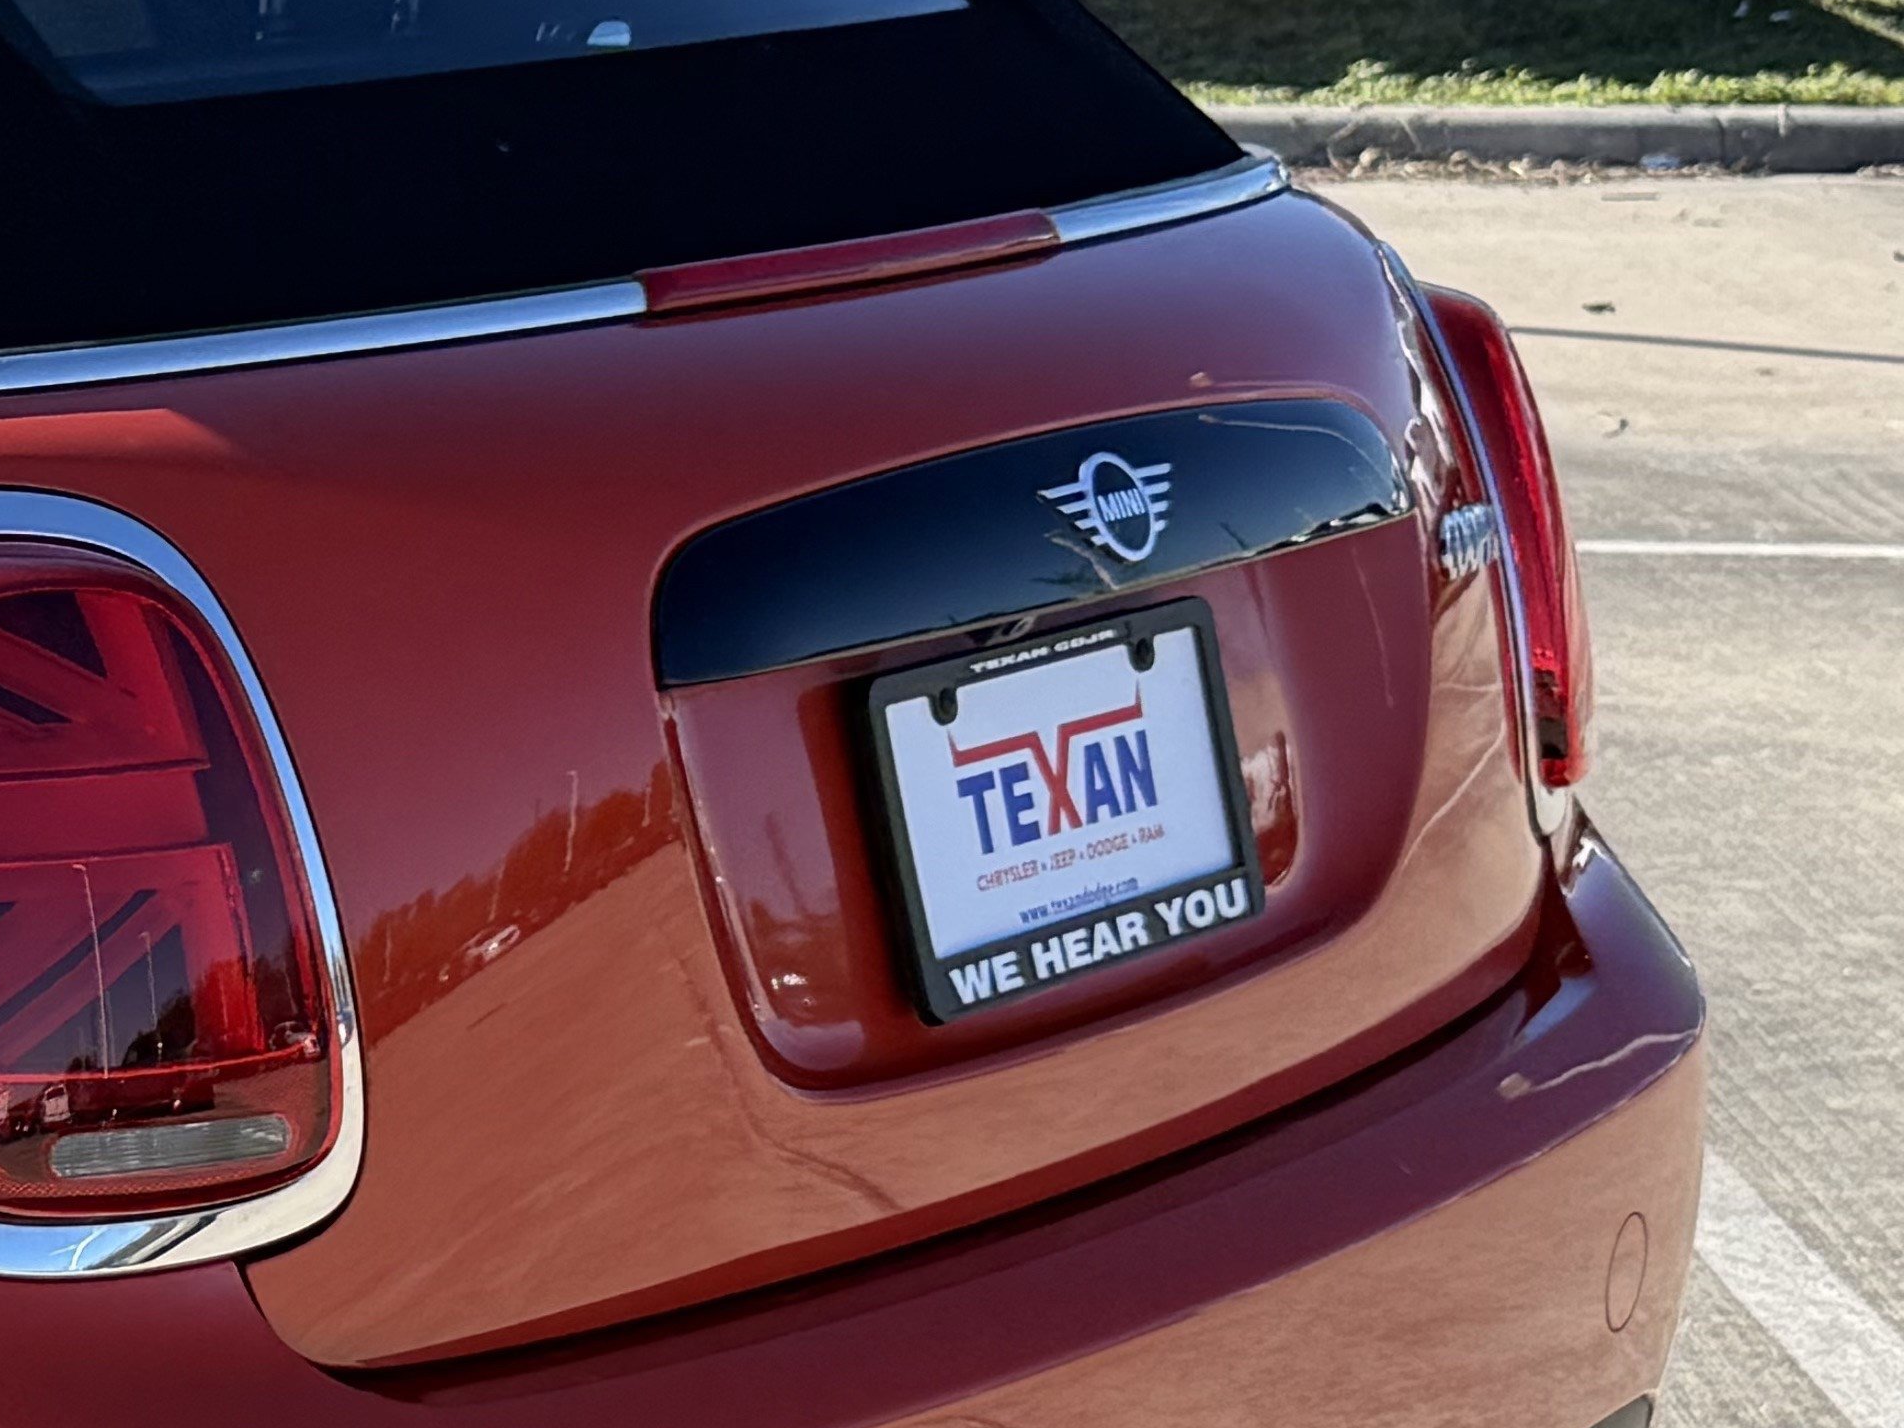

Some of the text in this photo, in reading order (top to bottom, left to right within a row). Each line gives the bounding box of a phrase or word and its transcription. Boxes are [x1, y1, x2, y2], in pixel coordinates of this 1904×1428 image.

[1097, 488, 1146, 522] MINI
[970, 646, 1050, 672] TEXAN
[956, 724, 1158, 855] TEXAN
[977, 860, 1040, 891] CHRYSLER
[1087, 834, 1129, 859] DODGE
[949, 878, 1248, 1004] WE HEAR YOU
